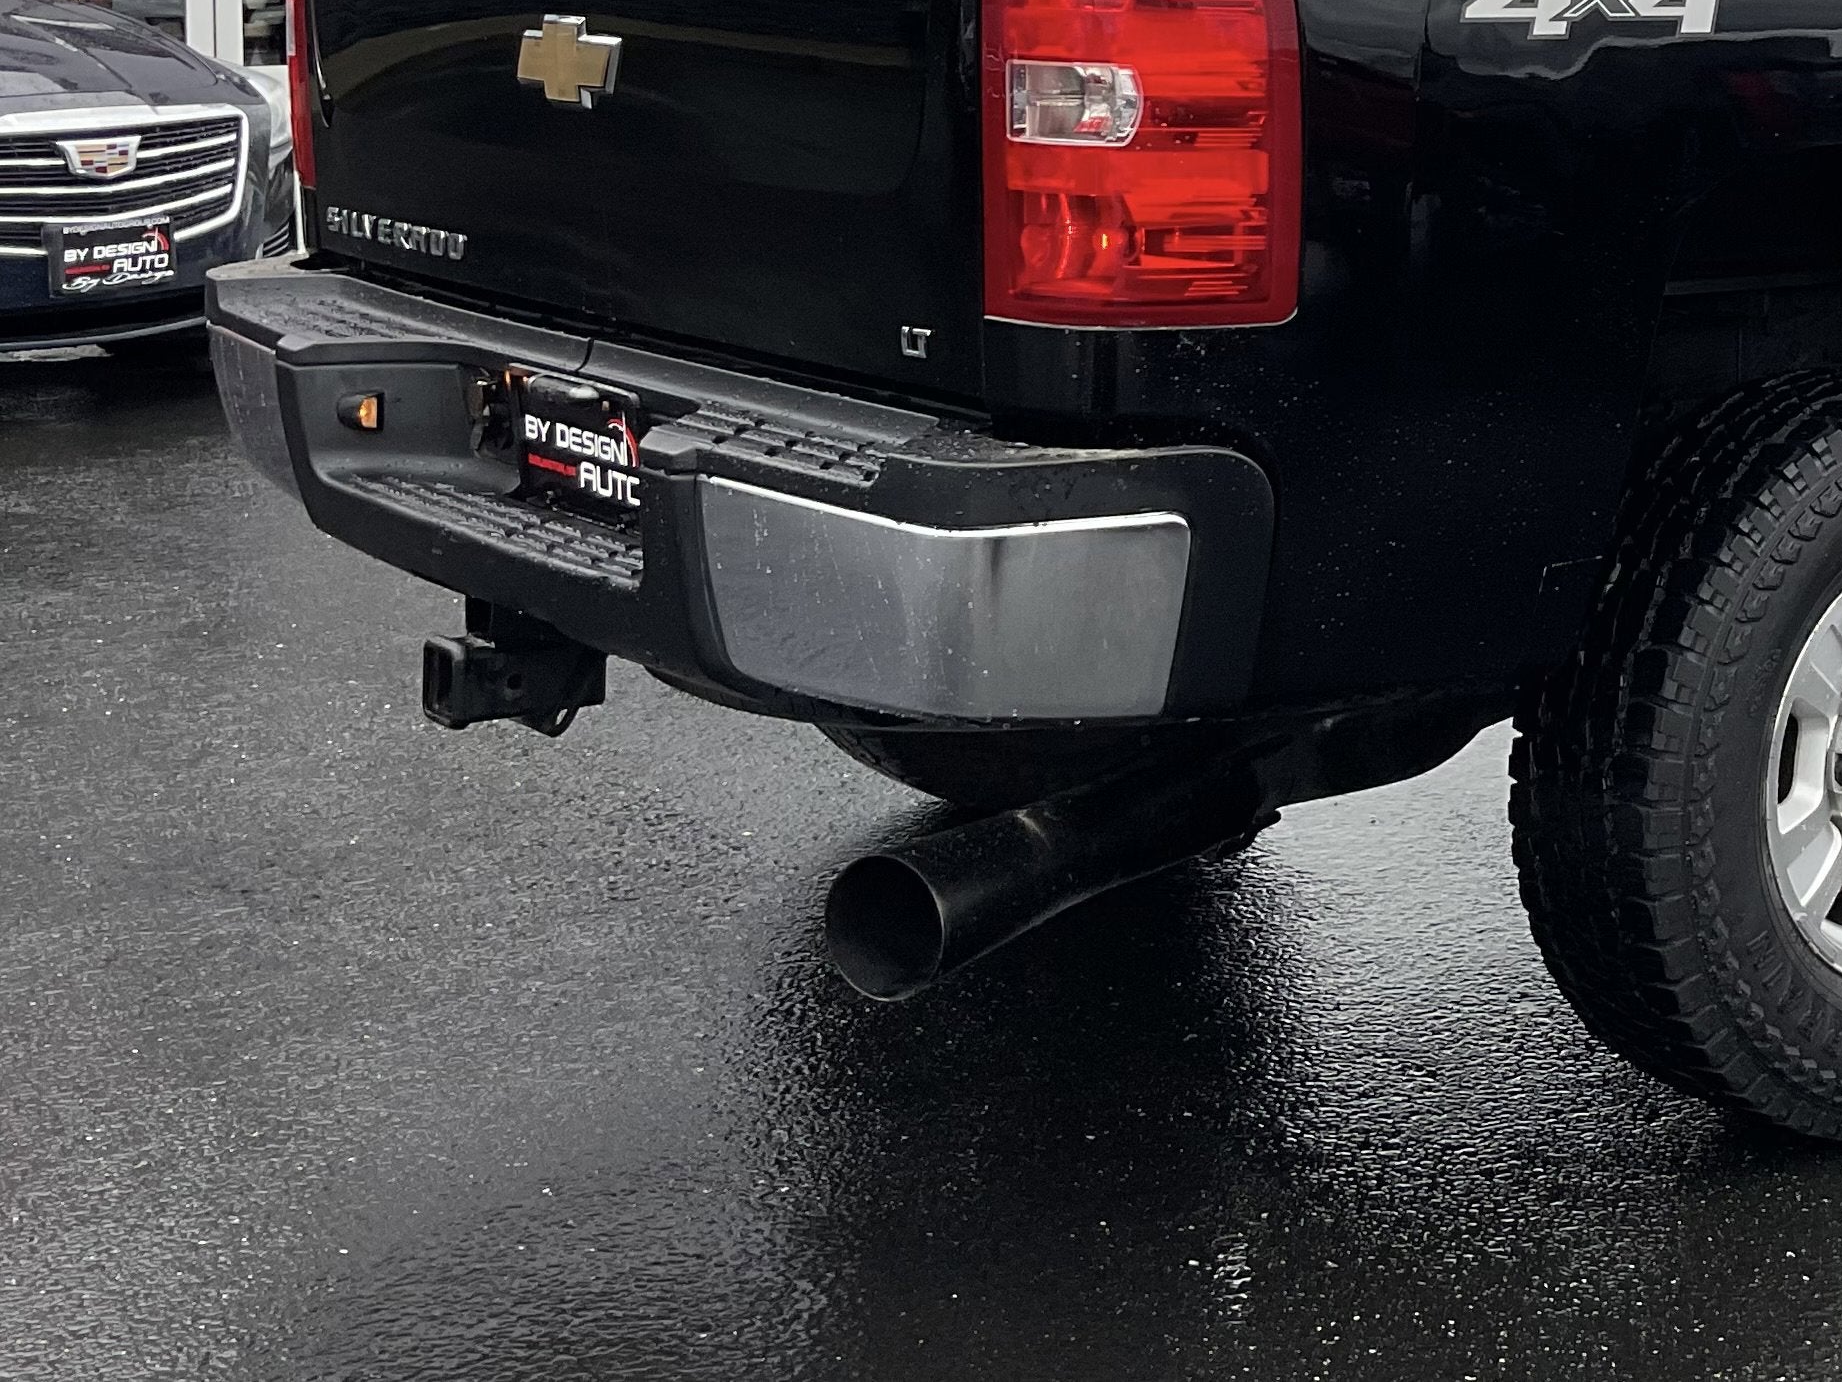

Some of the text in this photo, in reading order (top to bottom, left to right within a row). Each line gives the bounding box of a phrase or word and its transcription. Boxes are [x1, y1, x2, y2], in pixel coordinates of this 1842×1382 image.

[326, 206, 468, 260] SILVERADO
[64, 240, 157, 263] BY DESIGN
[113, 253, 169, 273] AUTO
[901, 326, 932, 358] LT
[525, 414, 550, 442] BY
[556, 423, 627, 466] DESIGN
